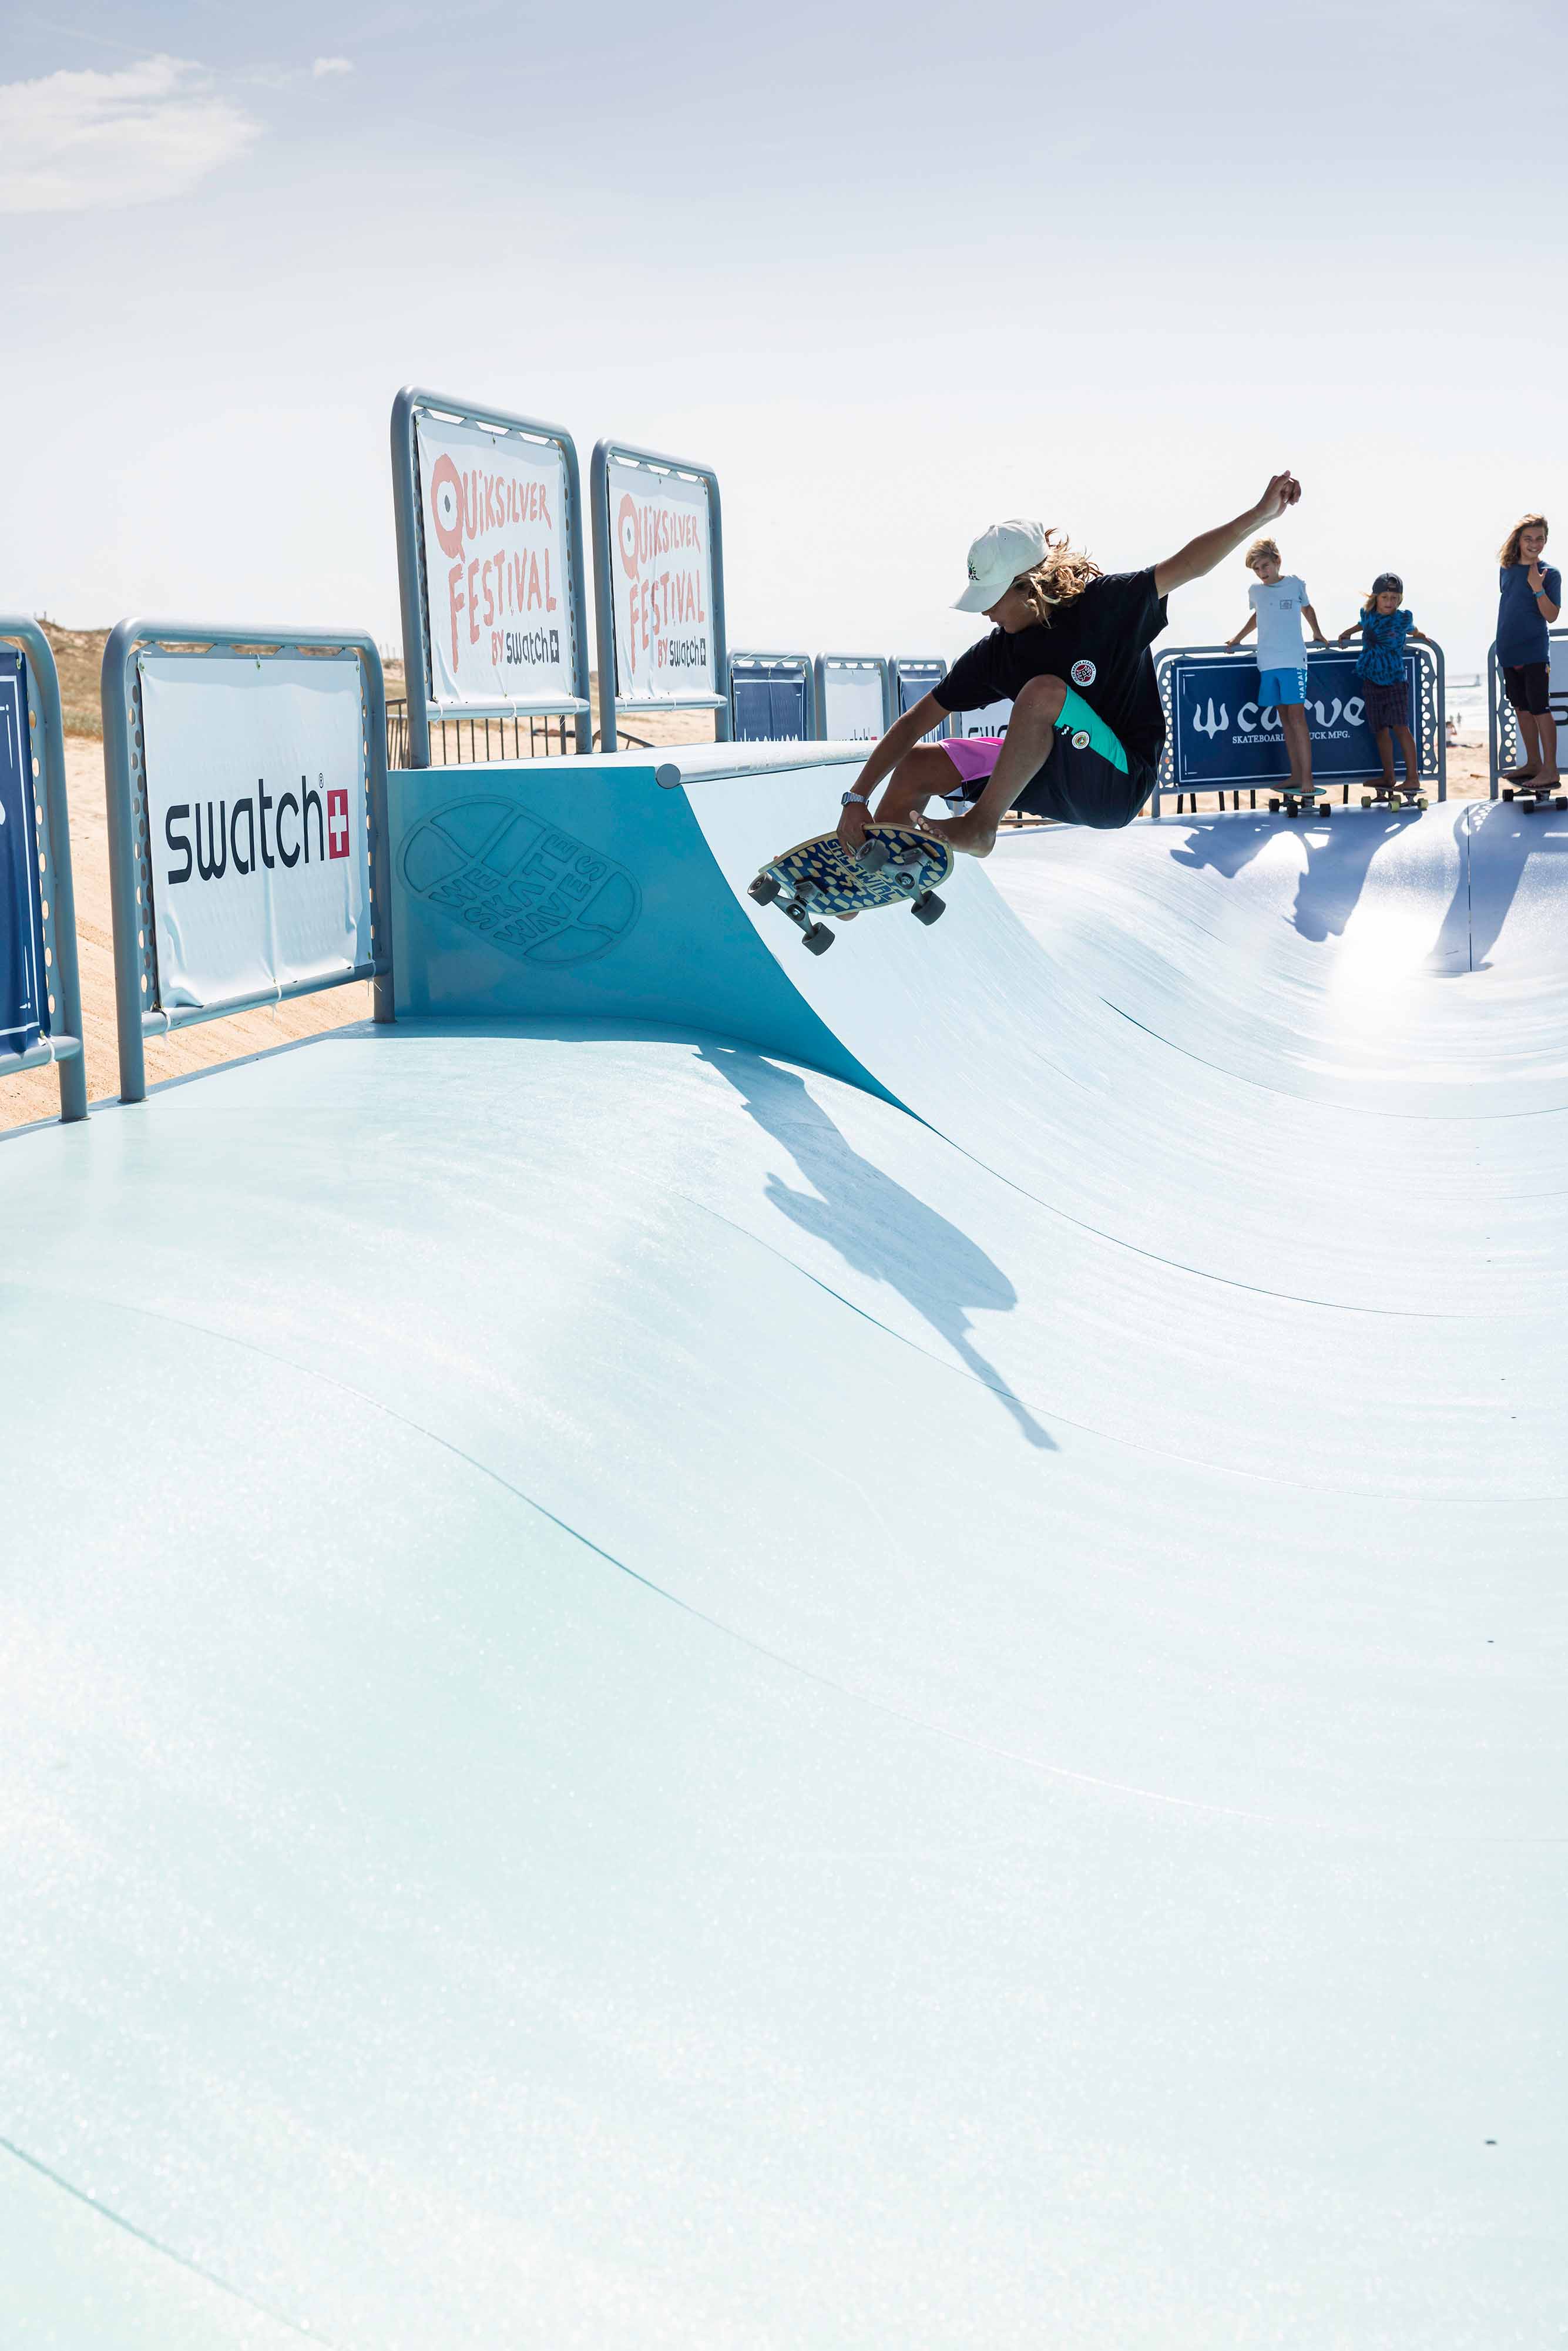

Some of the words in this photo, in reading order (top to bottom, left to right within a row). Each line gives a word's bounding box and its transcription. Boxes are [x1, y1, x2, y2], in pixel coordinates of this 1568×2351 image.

[448, 547, 557, 673] FESTIVAL
[629, 569, 705, 675] FESTIVAL
[491, 629, 504, 666] BY
[506, 626, 549, 665] swatch
[657, 637, 668, 668] BY
[669, 635, 699, 668] swatch
[1237, 696, 1365, 733] cave
[1309, 732, 1328, 740] UCK
[1328, 730, 1351, 739] MFG.
[429, 868, 501, 908] WE
[464, 834, 579, 930] SKATE
[493, 856, 607, 945] WAVES
